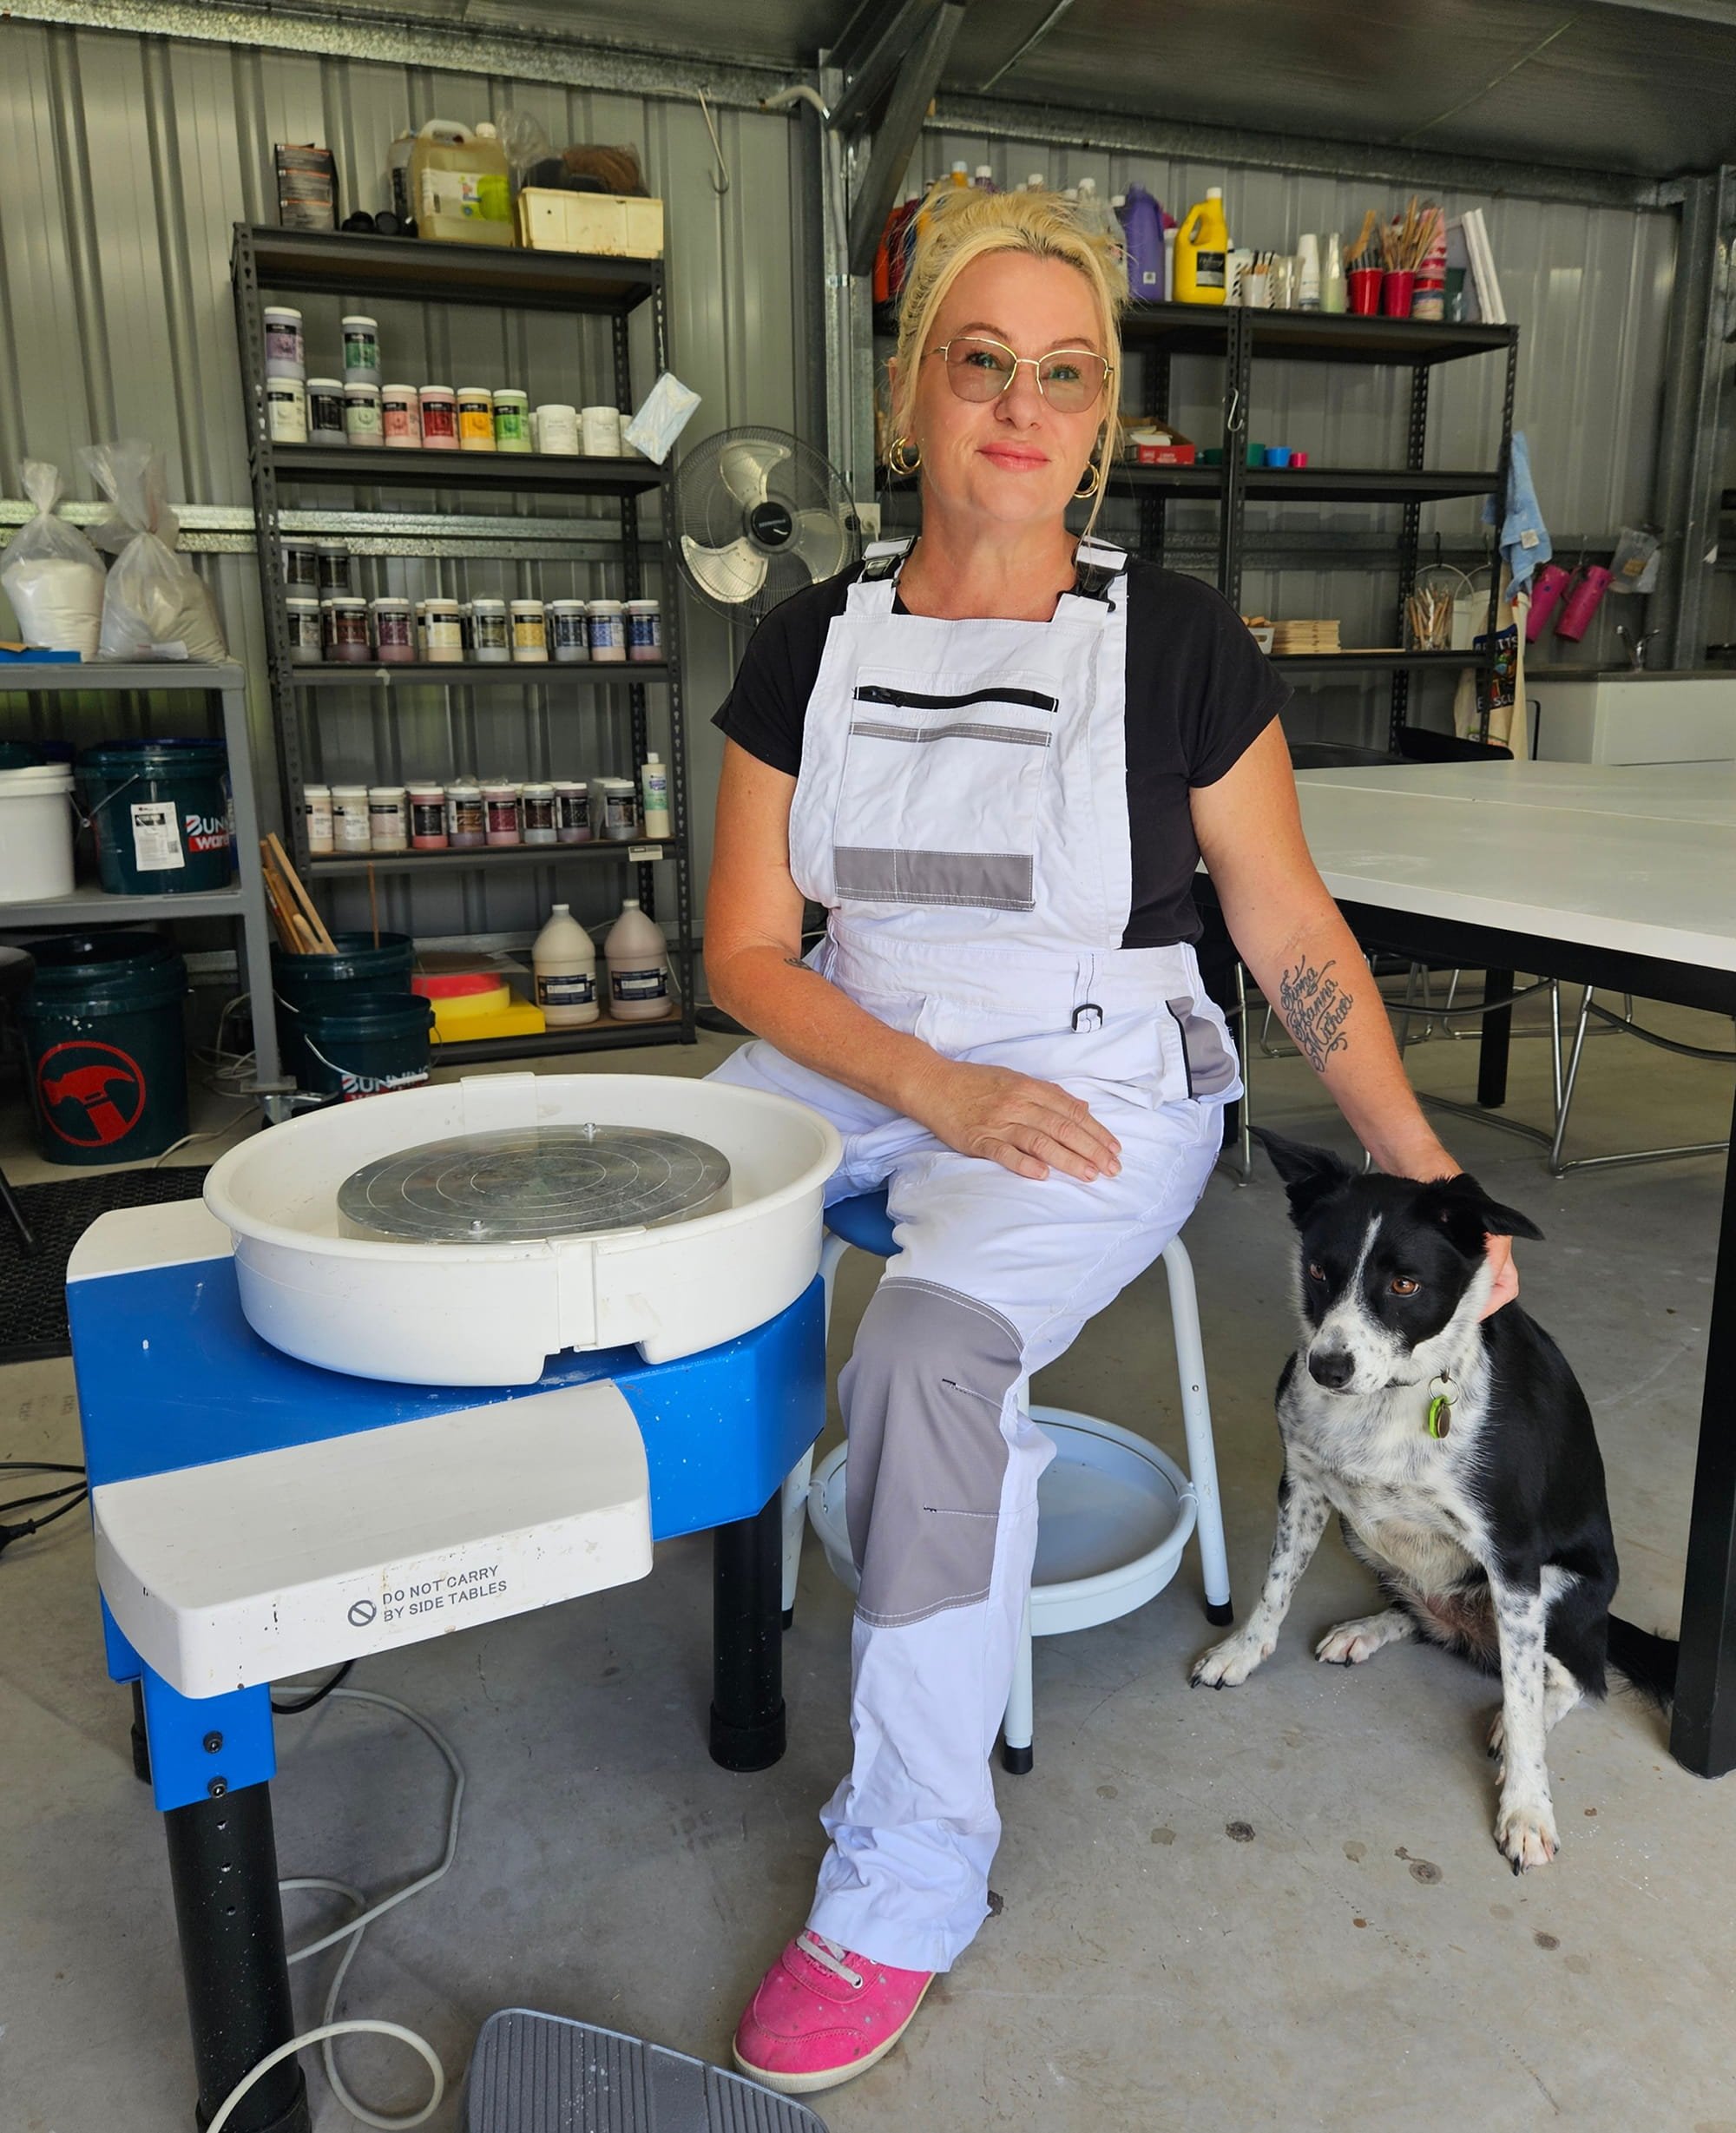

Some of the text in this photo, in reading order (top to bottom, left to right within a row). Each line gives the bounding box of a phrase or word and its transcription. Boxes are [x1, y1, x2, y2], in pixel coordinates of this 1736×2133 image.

[1286, 981, 1338, 1042] Hanna
[1304, 989, 1353, 1072] Michael
[382, 1564, 498, 1605] DO NOT CARRY
[384, 1580, 508, 1623] BY SIDE TABLES
